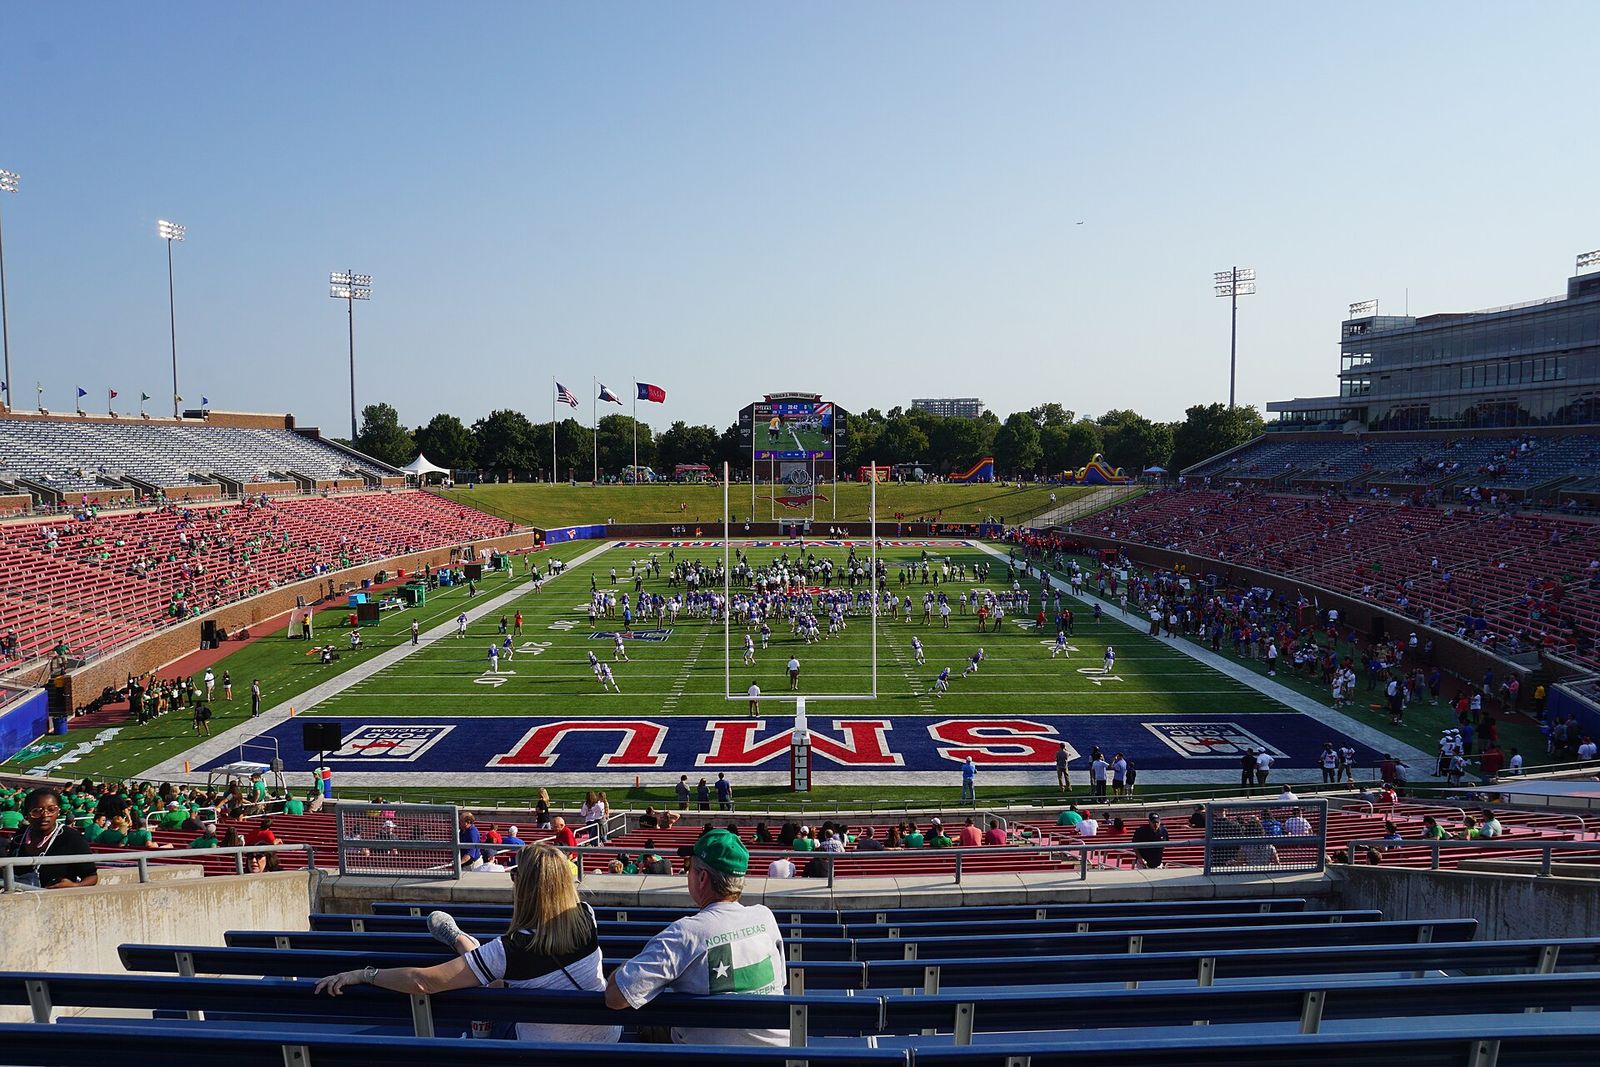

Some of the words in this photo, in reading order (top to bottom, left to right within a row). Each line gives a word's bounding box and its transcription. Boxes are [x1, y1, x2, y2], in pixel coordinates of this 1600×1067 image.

[485, 719, 1081, 767] SMU
[705, 931, 739, 947] NORTH
[740, 924, 766, 937] TEXAS
